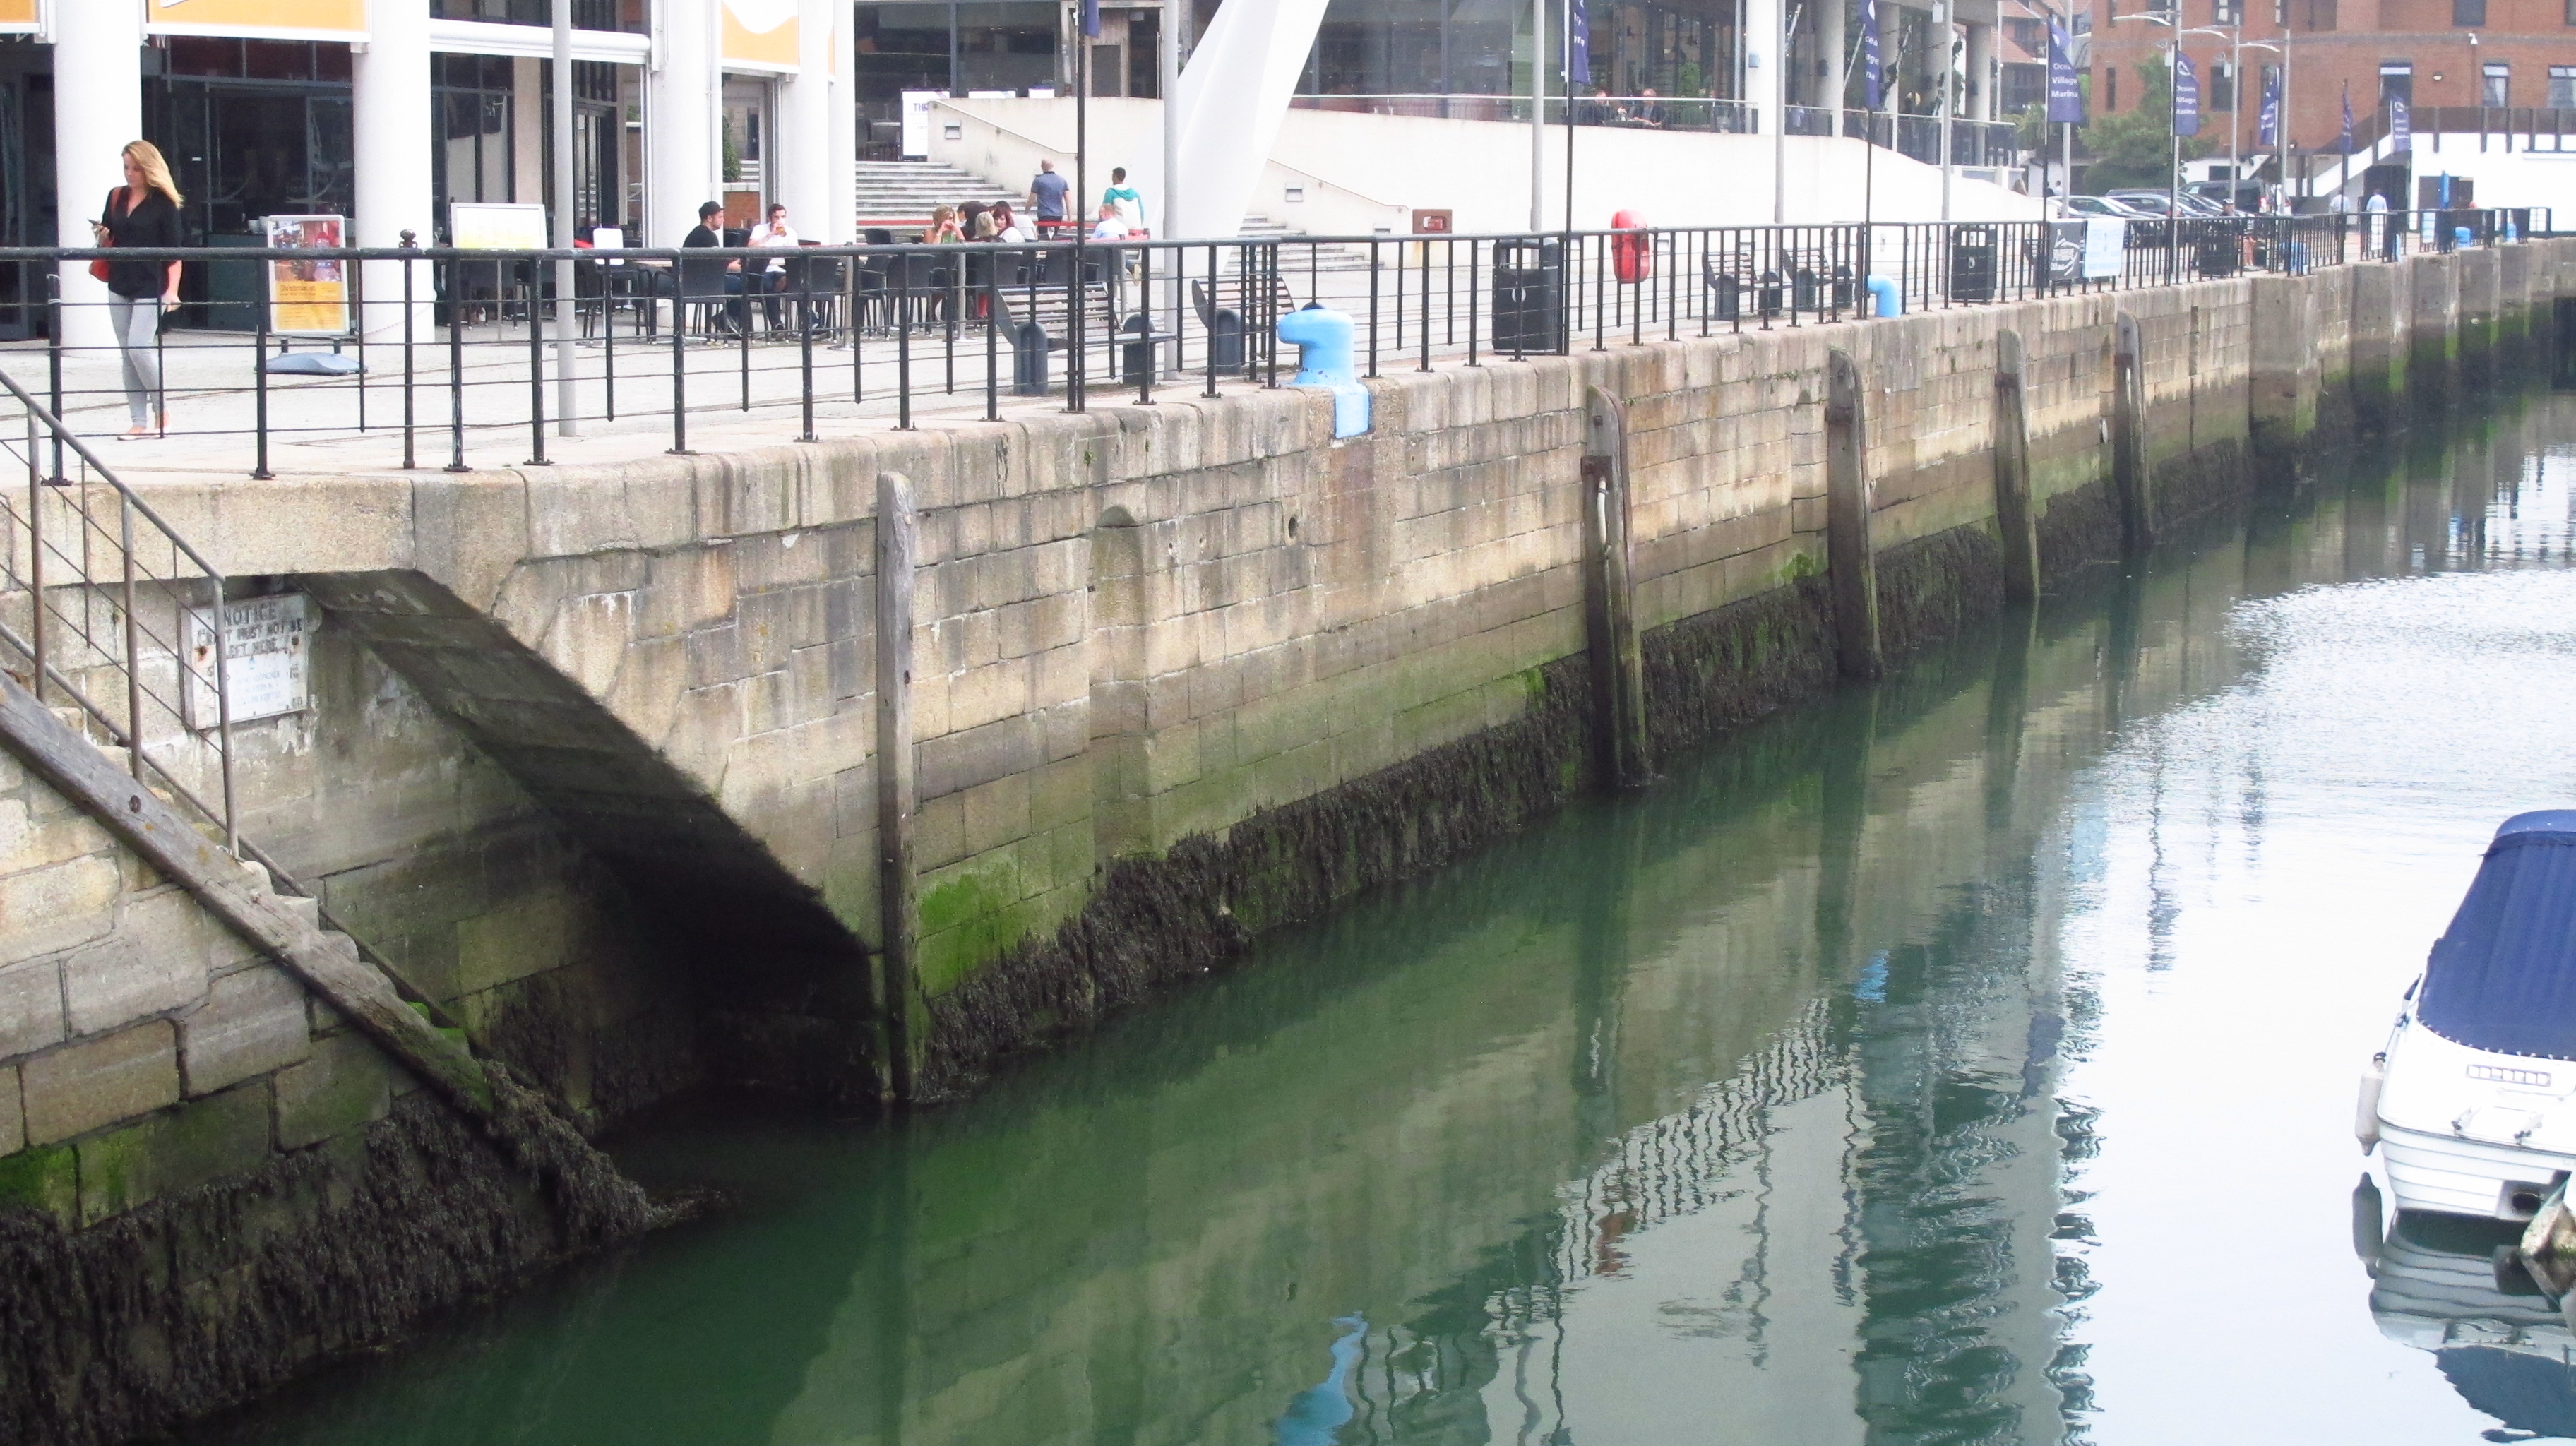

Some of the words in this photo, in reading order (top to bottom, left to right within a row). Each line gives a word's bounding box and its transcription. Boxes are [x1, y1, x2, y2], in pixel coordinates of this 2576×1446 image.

[224, 600, 278, 626] NOTICE
[268, 619, 286, 635] NOT
[290, 617, 303, 632] BE
